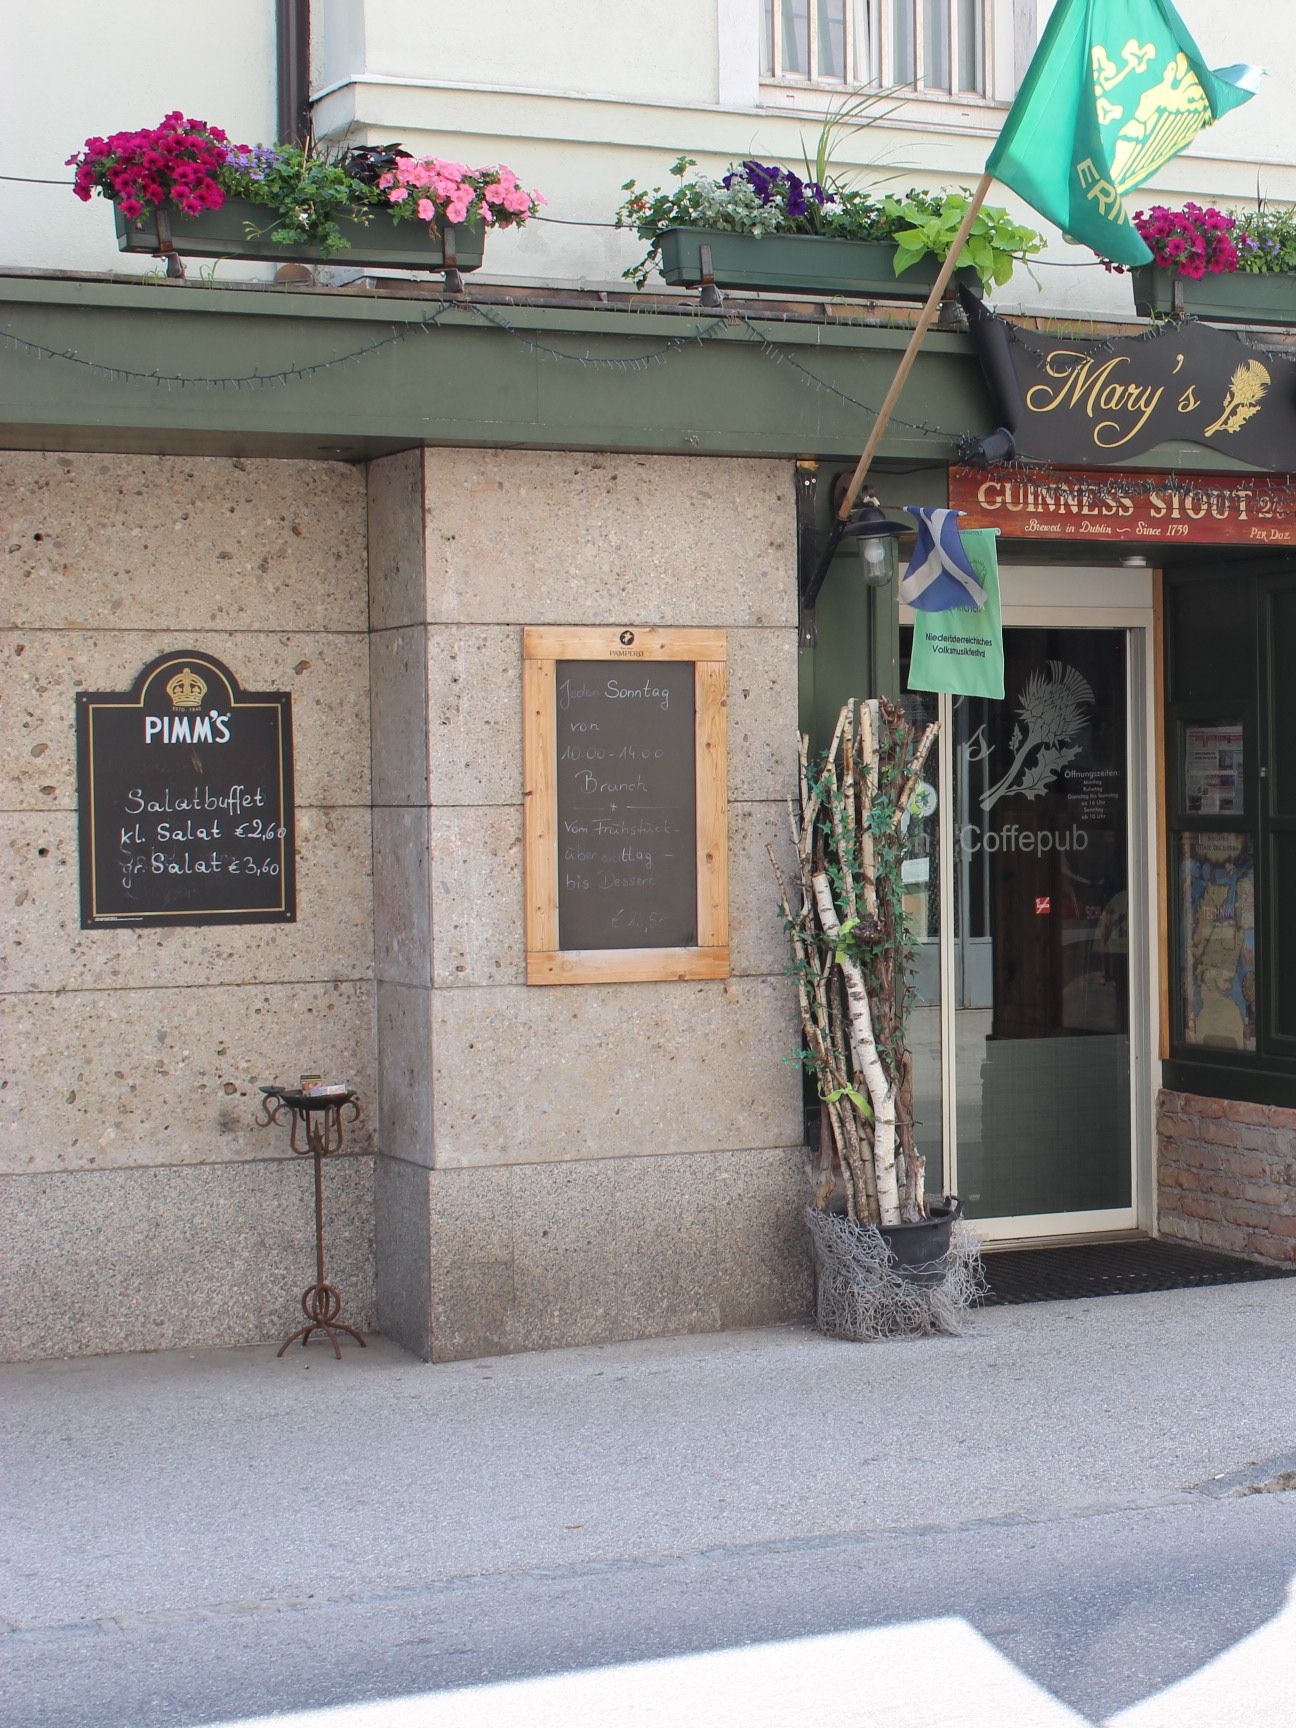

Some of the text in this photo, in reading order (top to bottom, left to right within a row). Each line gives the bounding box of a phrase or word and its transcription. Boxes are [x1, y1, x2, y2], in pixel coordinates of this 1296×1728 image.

[1026, 350, 1201, 448] Mary's
[977, 481, 1134, 517] GUINNESS
[1150, 488, 1252, 520] STOUT
[1024, 518, 1189, 537] Brewed in Dublin Since 1759
[604, 679, 670, 711] Sonntag
[145, 709, 231, 744] PIMM'S
[570, 722, 600, 733] von
[575, 769, 648, 794] Brunch
[124, 785, 265, 816] Salatbuffet
[120, 819, 287, 845] kl. Salat €2,60
[959, 823, 1089, 858] Coffepub
[121, 862, 145, 889] gr.
[151, 851, 222, 874] Salat
[566, 873, 590, 890] bis
